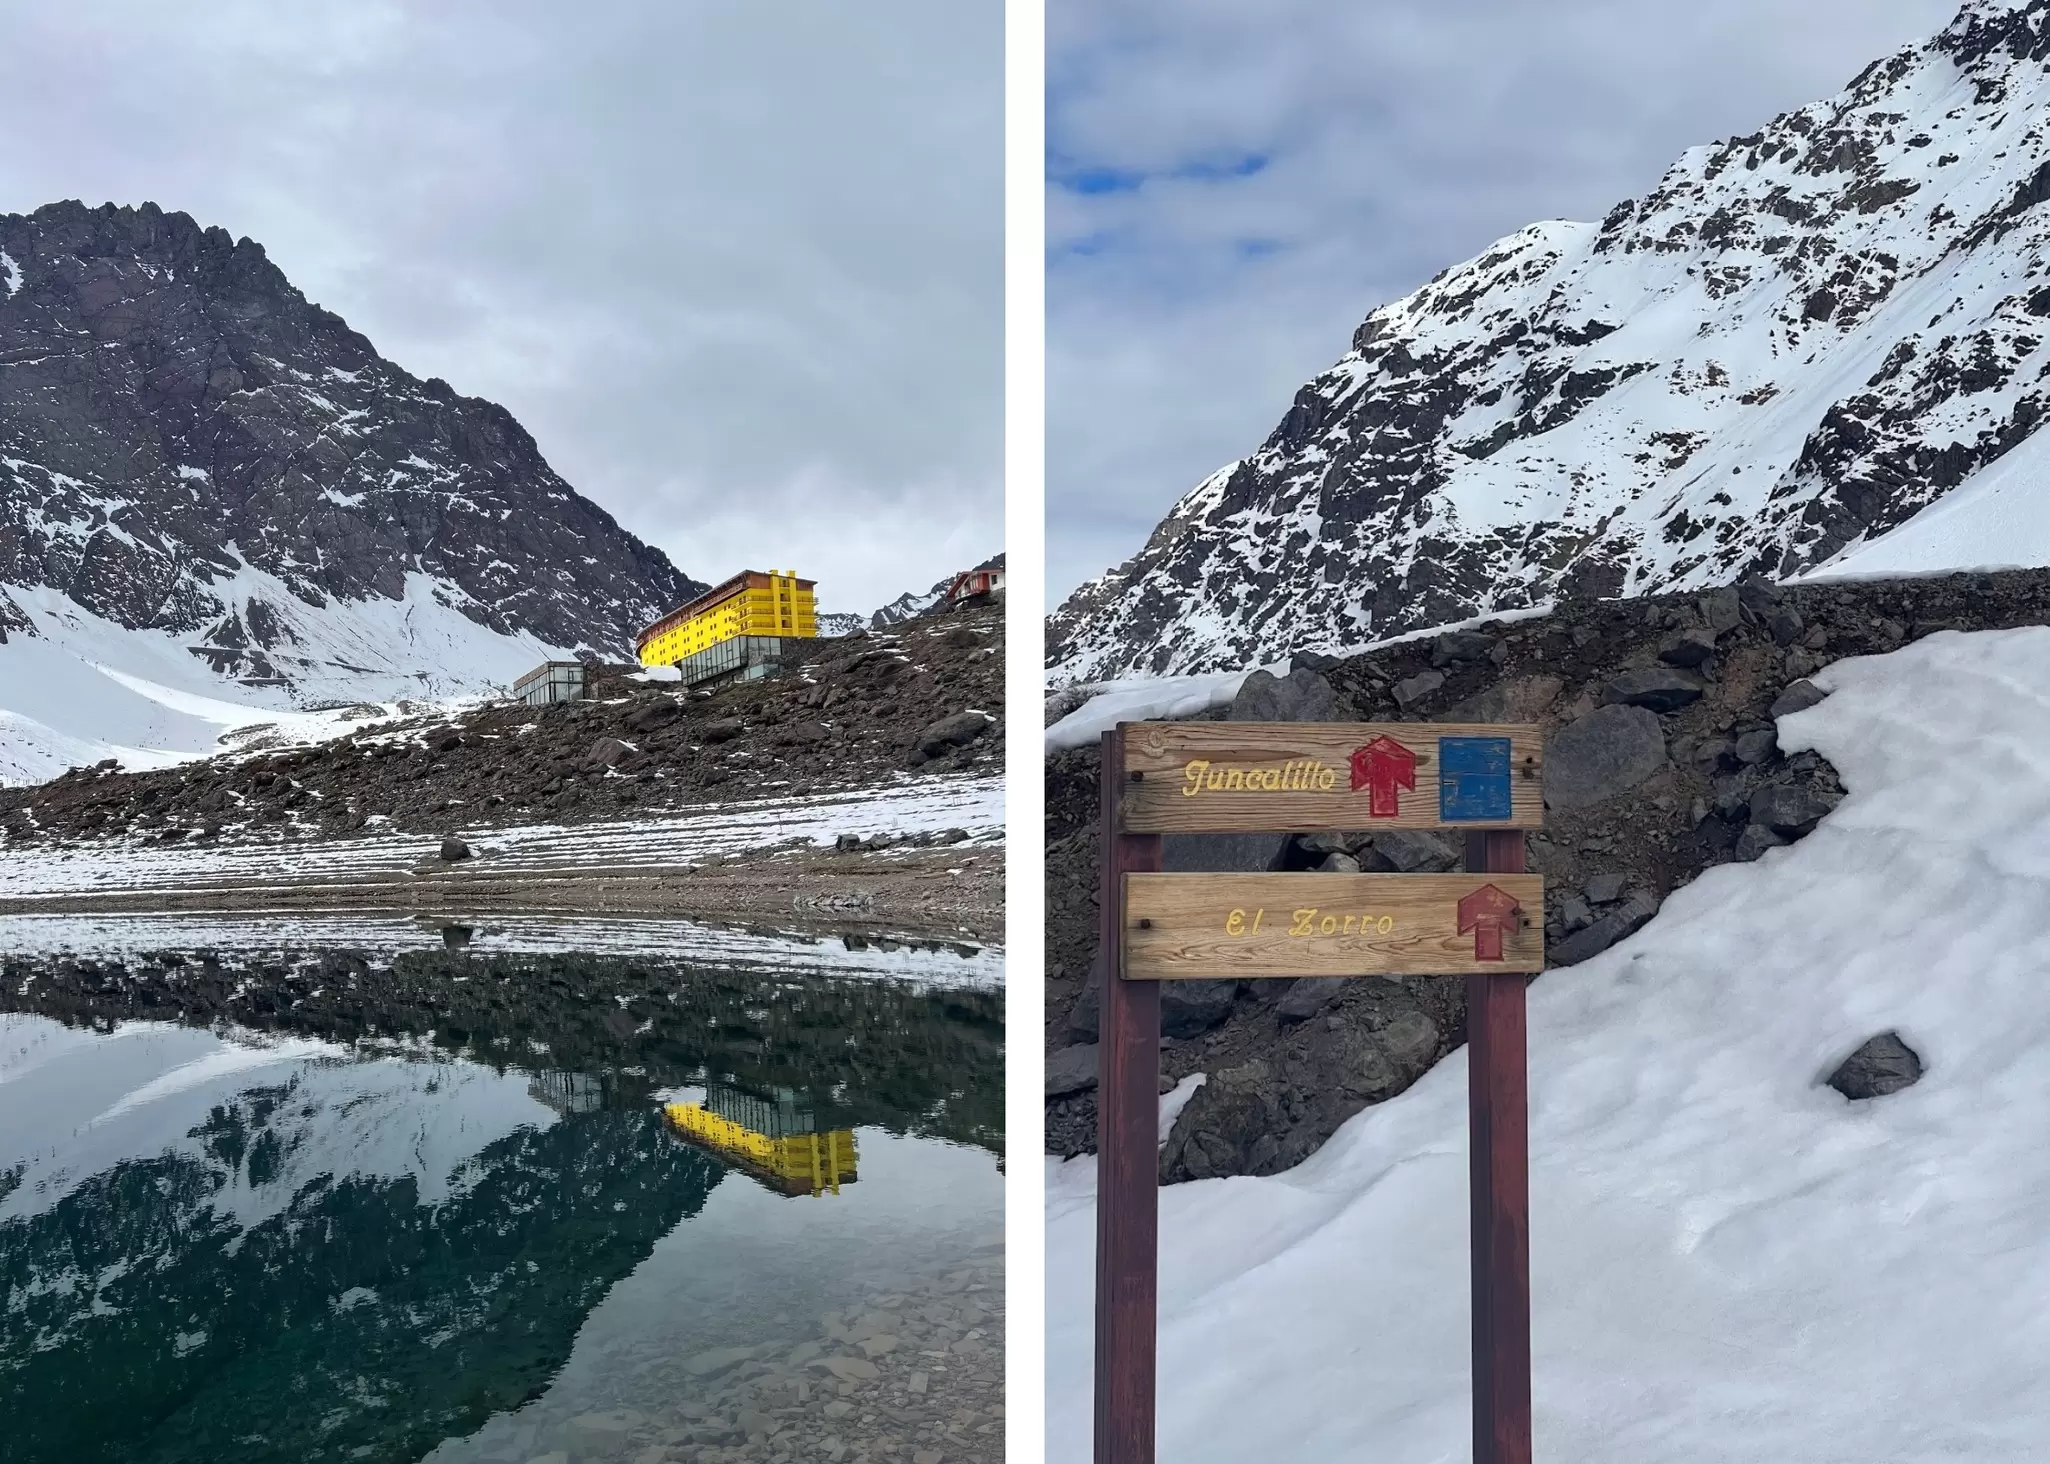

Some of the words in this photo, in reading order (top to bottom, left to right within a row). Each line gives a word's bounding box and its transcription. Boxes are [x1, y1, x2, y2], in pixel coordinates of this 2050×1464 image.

[1182, 760, 1336, 796] Juncalillo
[1225, 908, 1262, 936] El
[1288, 908, 1393, 936] Zorro
